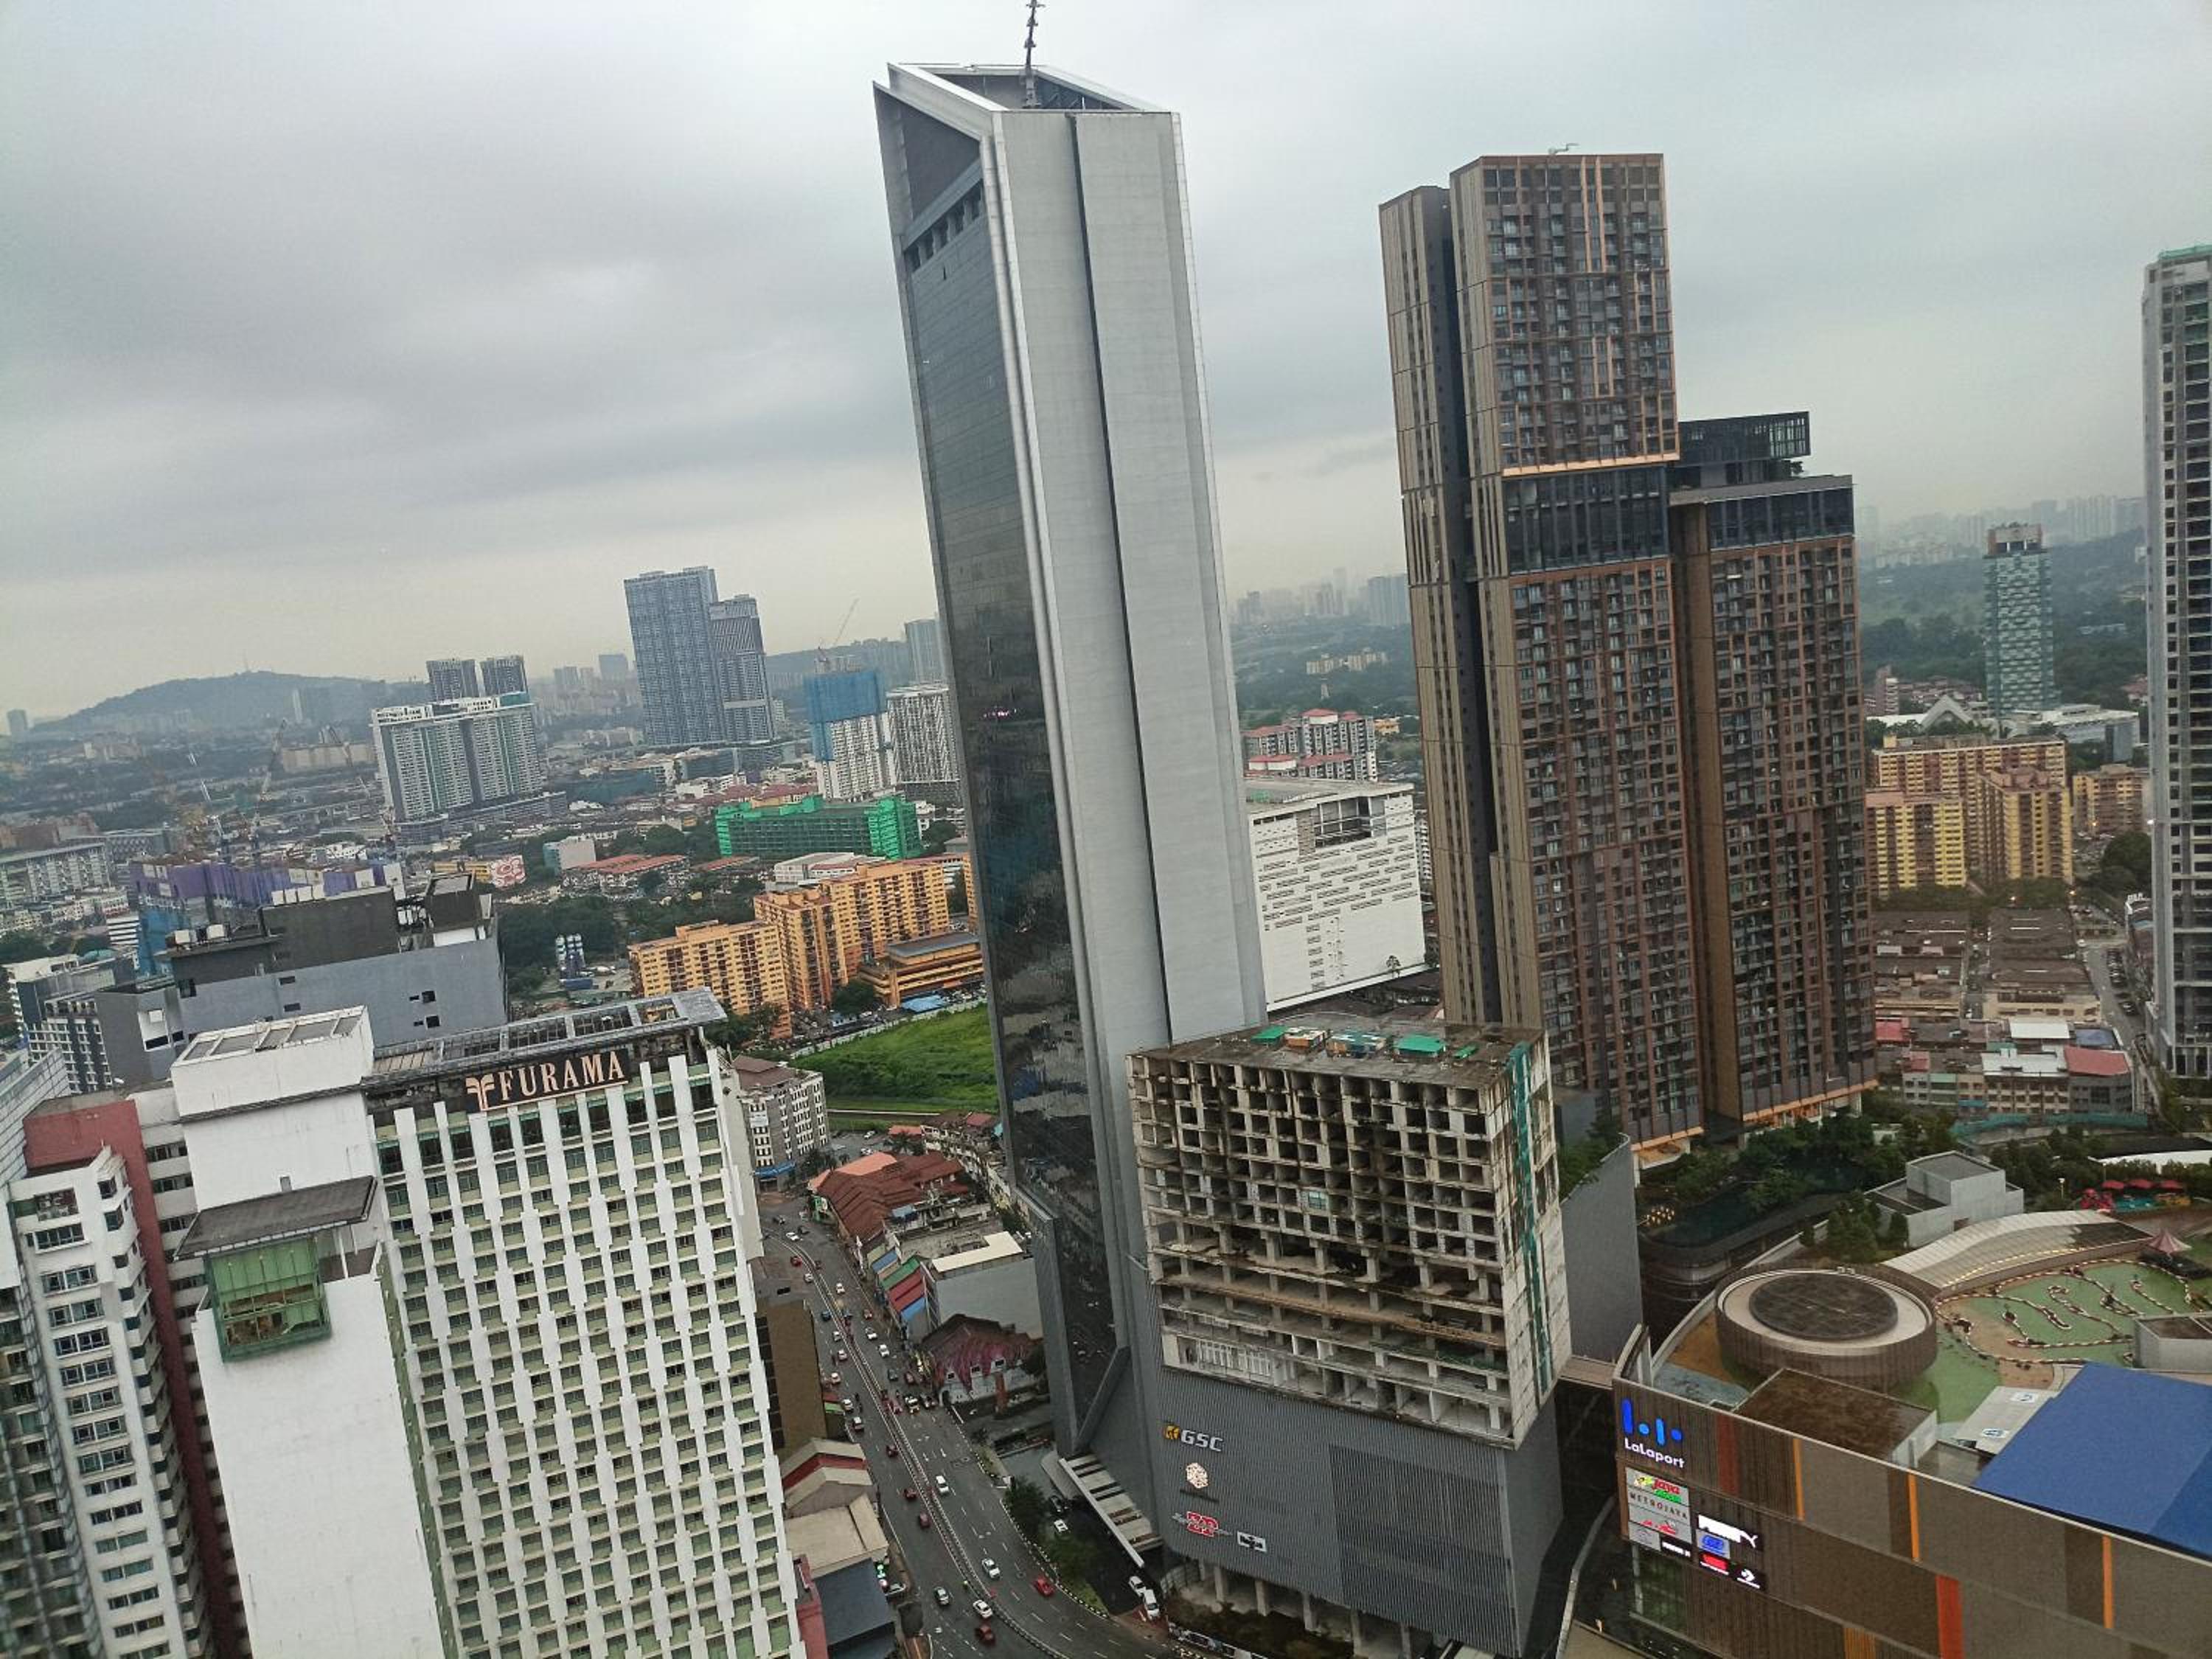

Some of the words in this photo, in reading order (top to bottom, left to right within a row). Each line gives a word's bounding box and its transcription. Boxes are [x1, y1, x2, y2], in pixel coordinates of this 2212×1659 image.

[498, 1051, 624, 1101] FURAMA
[1181, 1430, 1223, 1452] GSC
[1624, 1438, 1685, 1468] LaLaport
